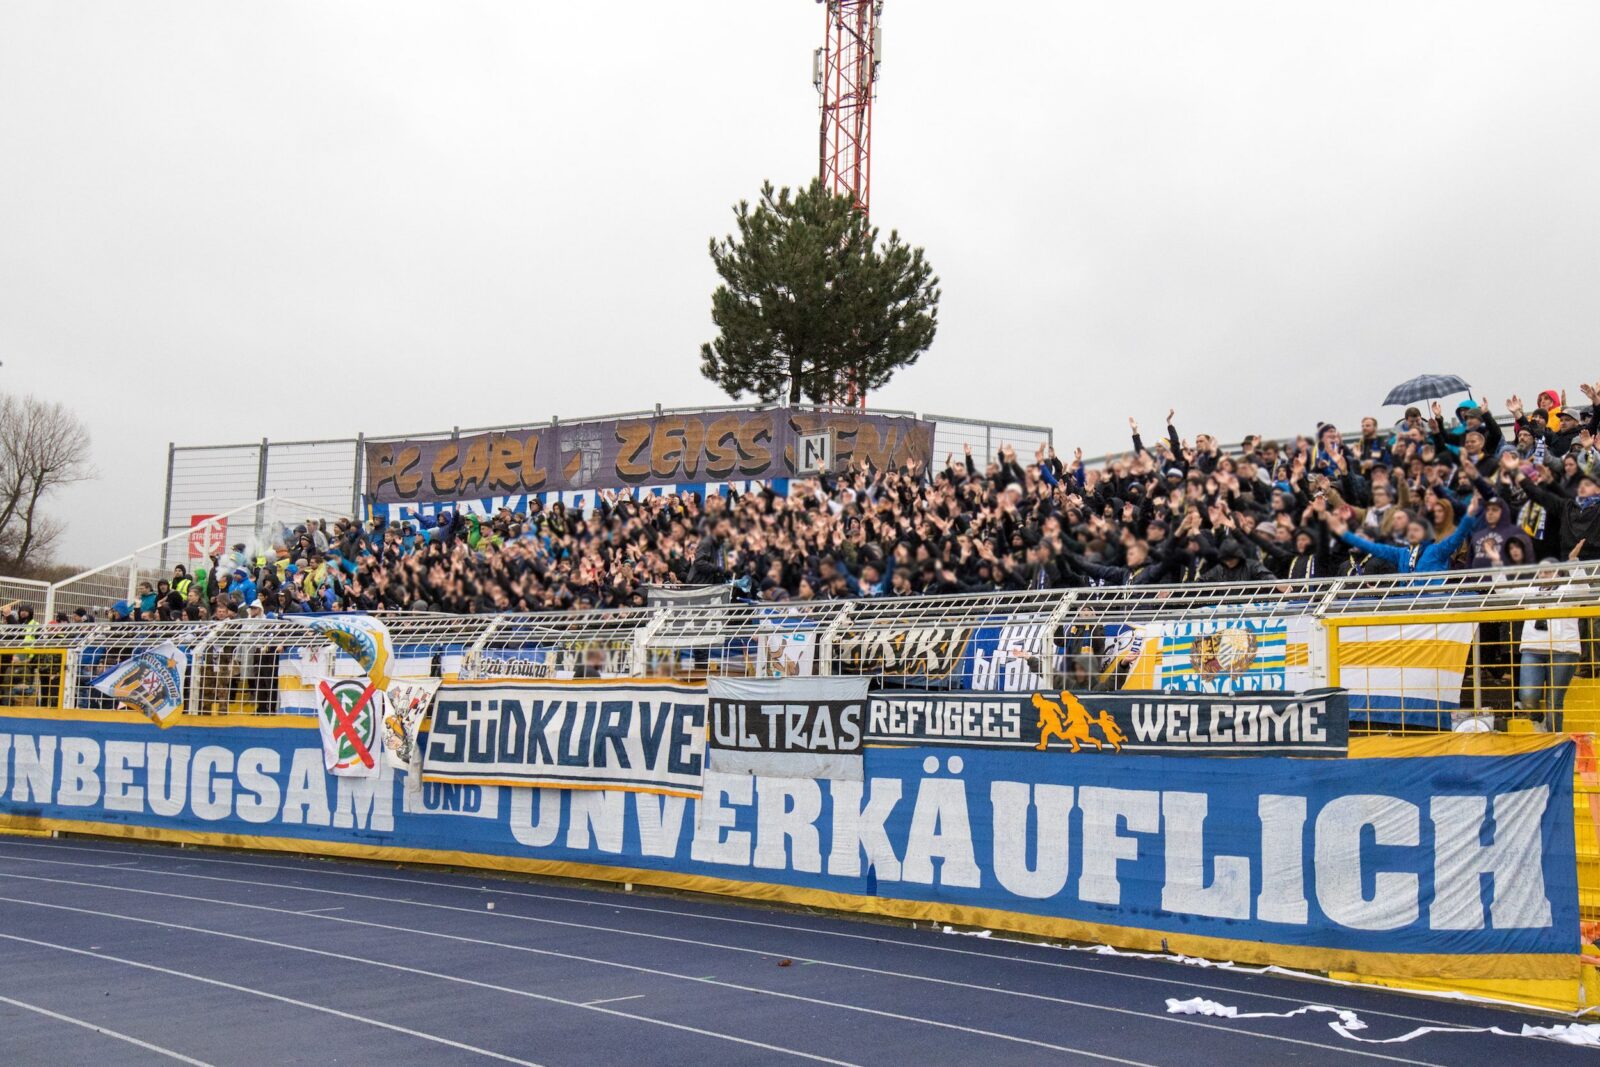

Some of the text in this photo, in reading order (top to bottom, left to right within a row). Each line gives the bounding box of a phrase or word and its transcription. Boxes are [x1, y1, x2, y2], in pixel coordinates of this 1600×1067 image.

[365, 443, 423, 502] FC
[430, 432, 547, 497] CARL
[615, 415, 773, 484] ZEISS
[429, 699, 705, 775] SÜDKURVE
[714, 704, 861, 750] ULTRAS
[868, 700, 1327, 743] REFUGEES WELCOME
[422, 782, 482, 812] UND
[510, 756, 1553, 931] UNVERKÄUFLICH
